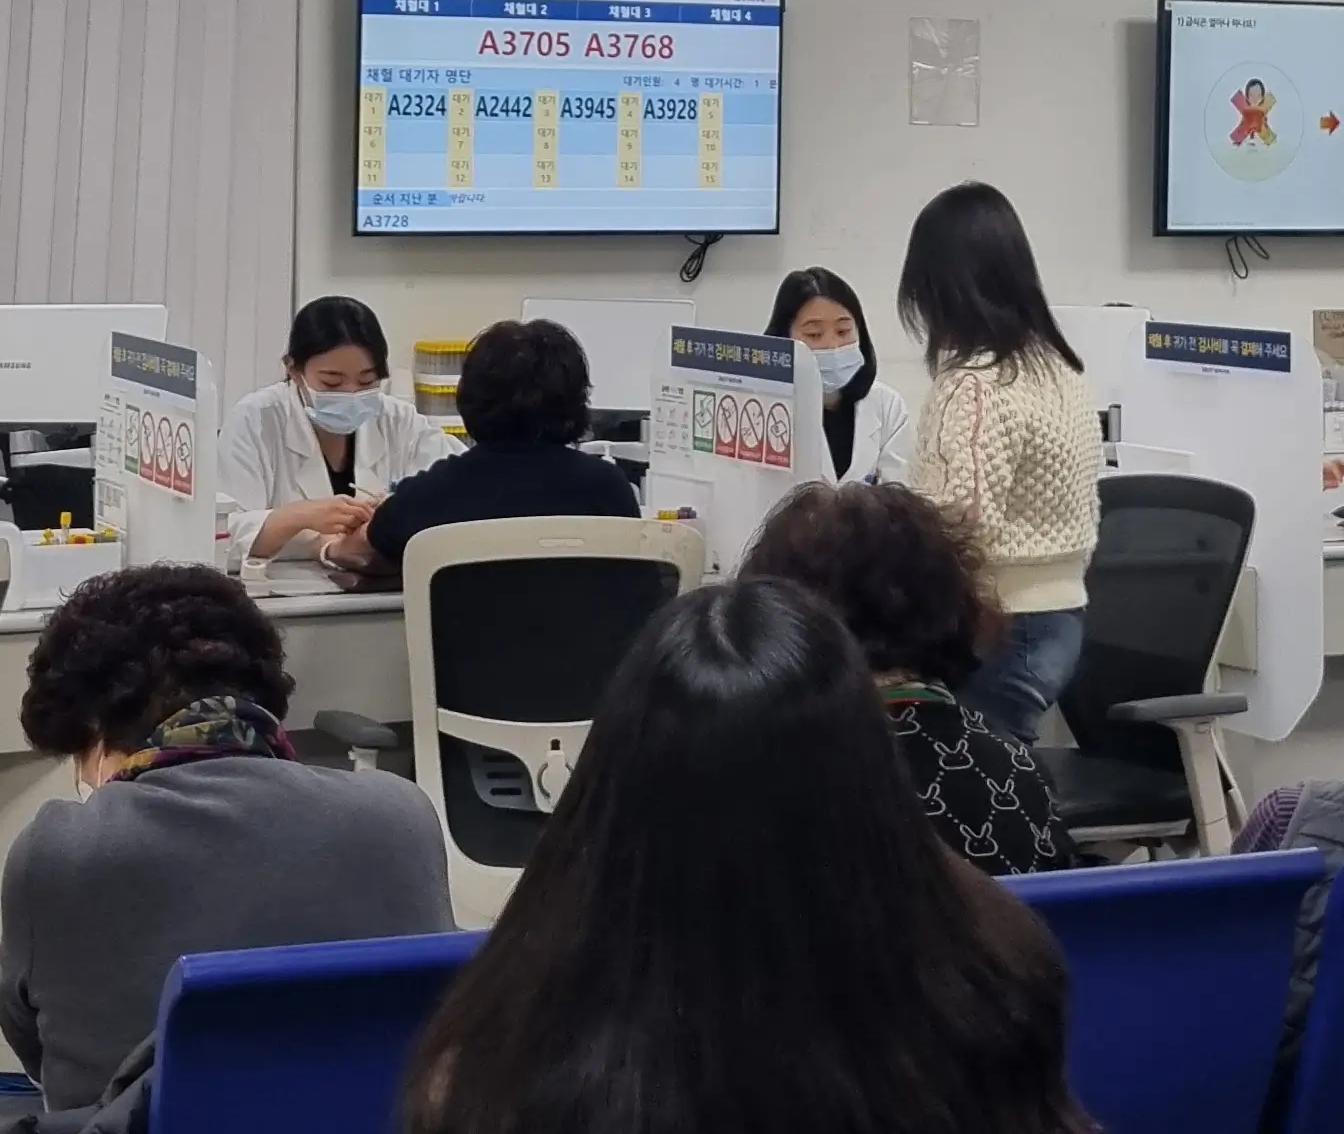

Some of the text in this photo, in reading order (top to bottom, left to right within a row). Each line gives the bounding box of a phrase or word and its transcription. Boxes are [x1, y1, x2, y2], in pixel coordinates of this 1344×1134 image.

[395, 0, 439, 12] 채혈대 1
[504, 3, 547, 16] 채혈대 2
[608, 5, 651, 18] 채혈대 3
[711, 8, 751, 21] 채혈대 4
[478, 30, 673, 59] A3705 A3768
[366, 68, 471, 83] 채혈 대기자 명단
[674, 77, 680, 87] 4
[691, 77, 699, 88] 명
[364, 93, 383, 103] 대기
[452, 94, 470, 104] 대기
[539, 95, 556, 105] 대기
[621, 97, 639, 106] 대기
[703, 98, 719, 108] 대기
[388, 93, 447, 117] A2324
[475, 94, 532, 119] A2442
[560, 96, 616, 119] A3945
[643, 97, 697, 120] A3928
[364, 126, 382, 137] 대기
[452, 127, 470, 137] 대기
[538, 127, 555, 138] 대기
[621, 128, 638, 139] 대기
[703, 129, 719, 139] 대기
[364, 159, 381, 170] 대기
[452, 160, 469, 170] 대기
[538, 160, 554, 170] 대기
[621, 160, 637, 170] 대기
[702, 161, 718, 171] 대기
[372, 192, 394, 205] 순서
[401, 192, 422, 205] 지난
[427, 193, 437, 205] 분
[363, 215, 409, 228] A3728
[1198, 337, 1228, 354] 검사비를
[1241, 341, 1262, 357] 결제해
[1265, 343, 1287, 358] 주세요
